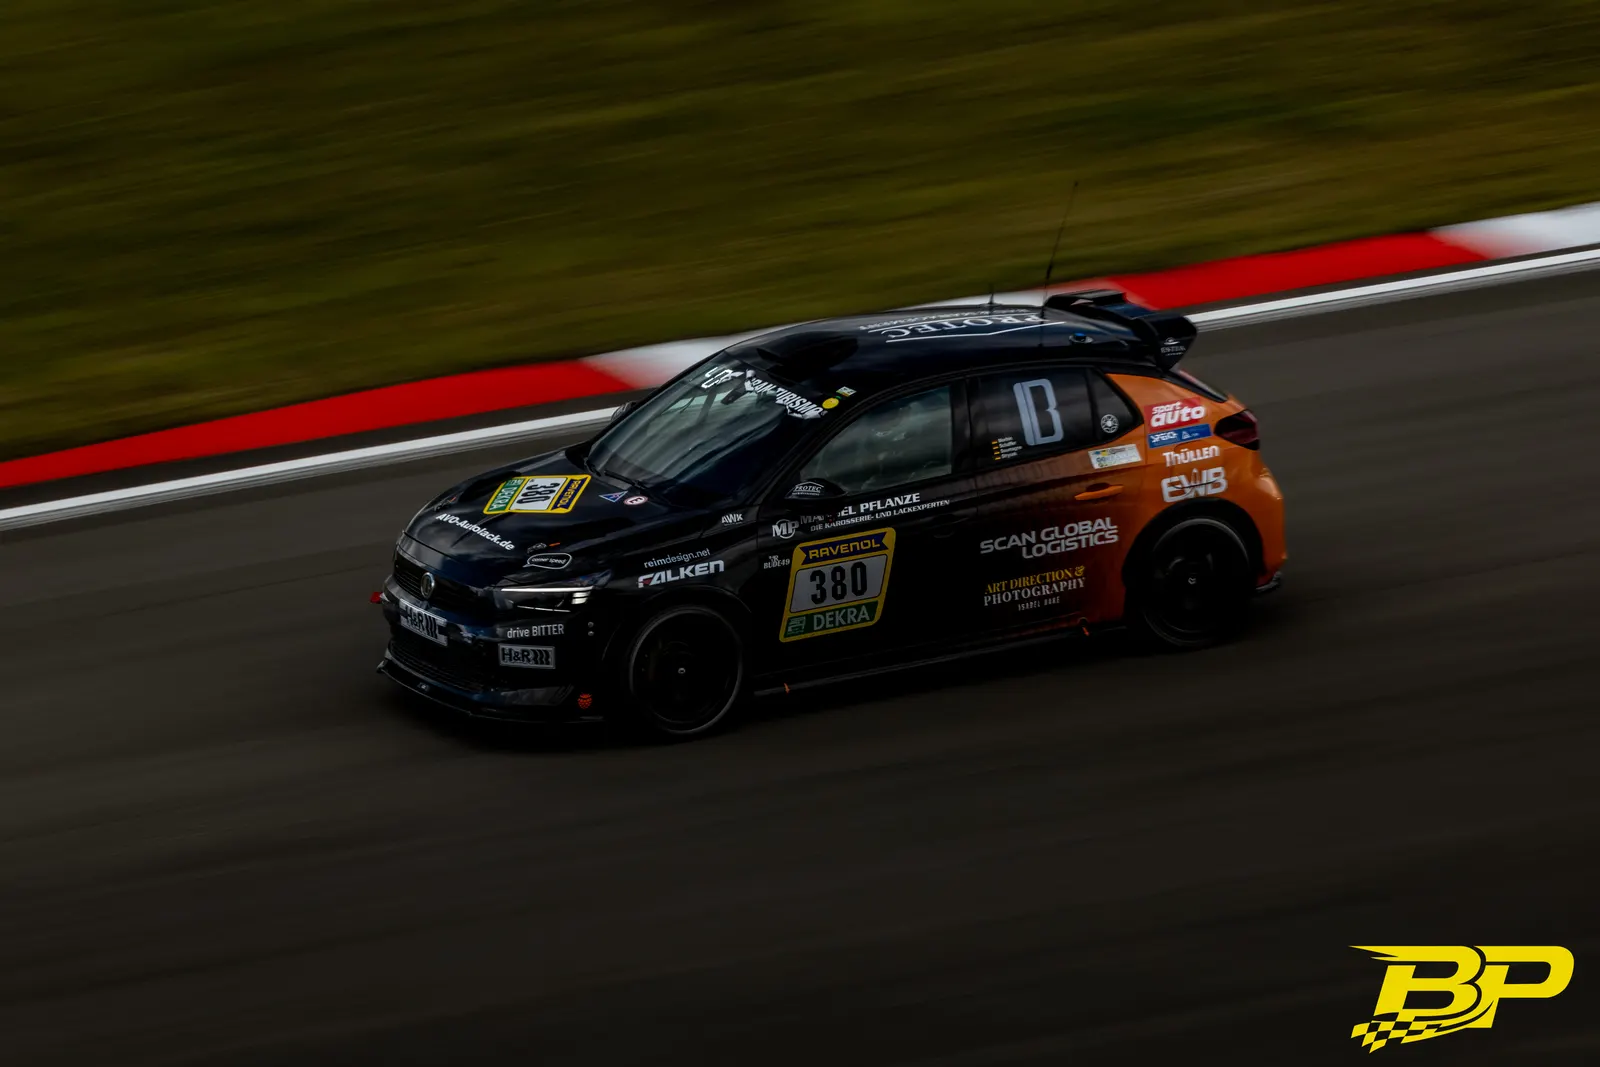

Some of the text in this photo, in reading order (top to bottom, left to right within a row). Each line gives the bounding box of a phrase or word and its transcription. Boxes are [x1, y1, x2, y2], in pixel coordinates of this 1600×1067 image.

[1150, 405, 1206, 428] auto
[517, 482, 560, 506] 380
[860, 492, 921, 512] PFLANZE
[721, 513, 744, 524] AWK
[810, 499, 951, 532] DIE KAROSSERIE- UND LACKEXPERTEN
[435, 513, 516, 551] AVO-Autolack.de
[979, 517, 1118, 555] SCAN GLOBAL
[1021, 529, 1119, 560] LOGISTICS
[643, 548, 711, 569] reimdesign.net
[808, 538, 881, 560] RAVENOL
[638, 559, 725, 588] FALKEN
[809, 561, 868, 605] 380
[984, 565, 1086, 595] ART DIRECTION &
[983, 577, 1086, 607] PHOTOGRAPHY
[507, 623, 565, 639] drive BITTER
[812, 604, 871, 631] DEKRA
